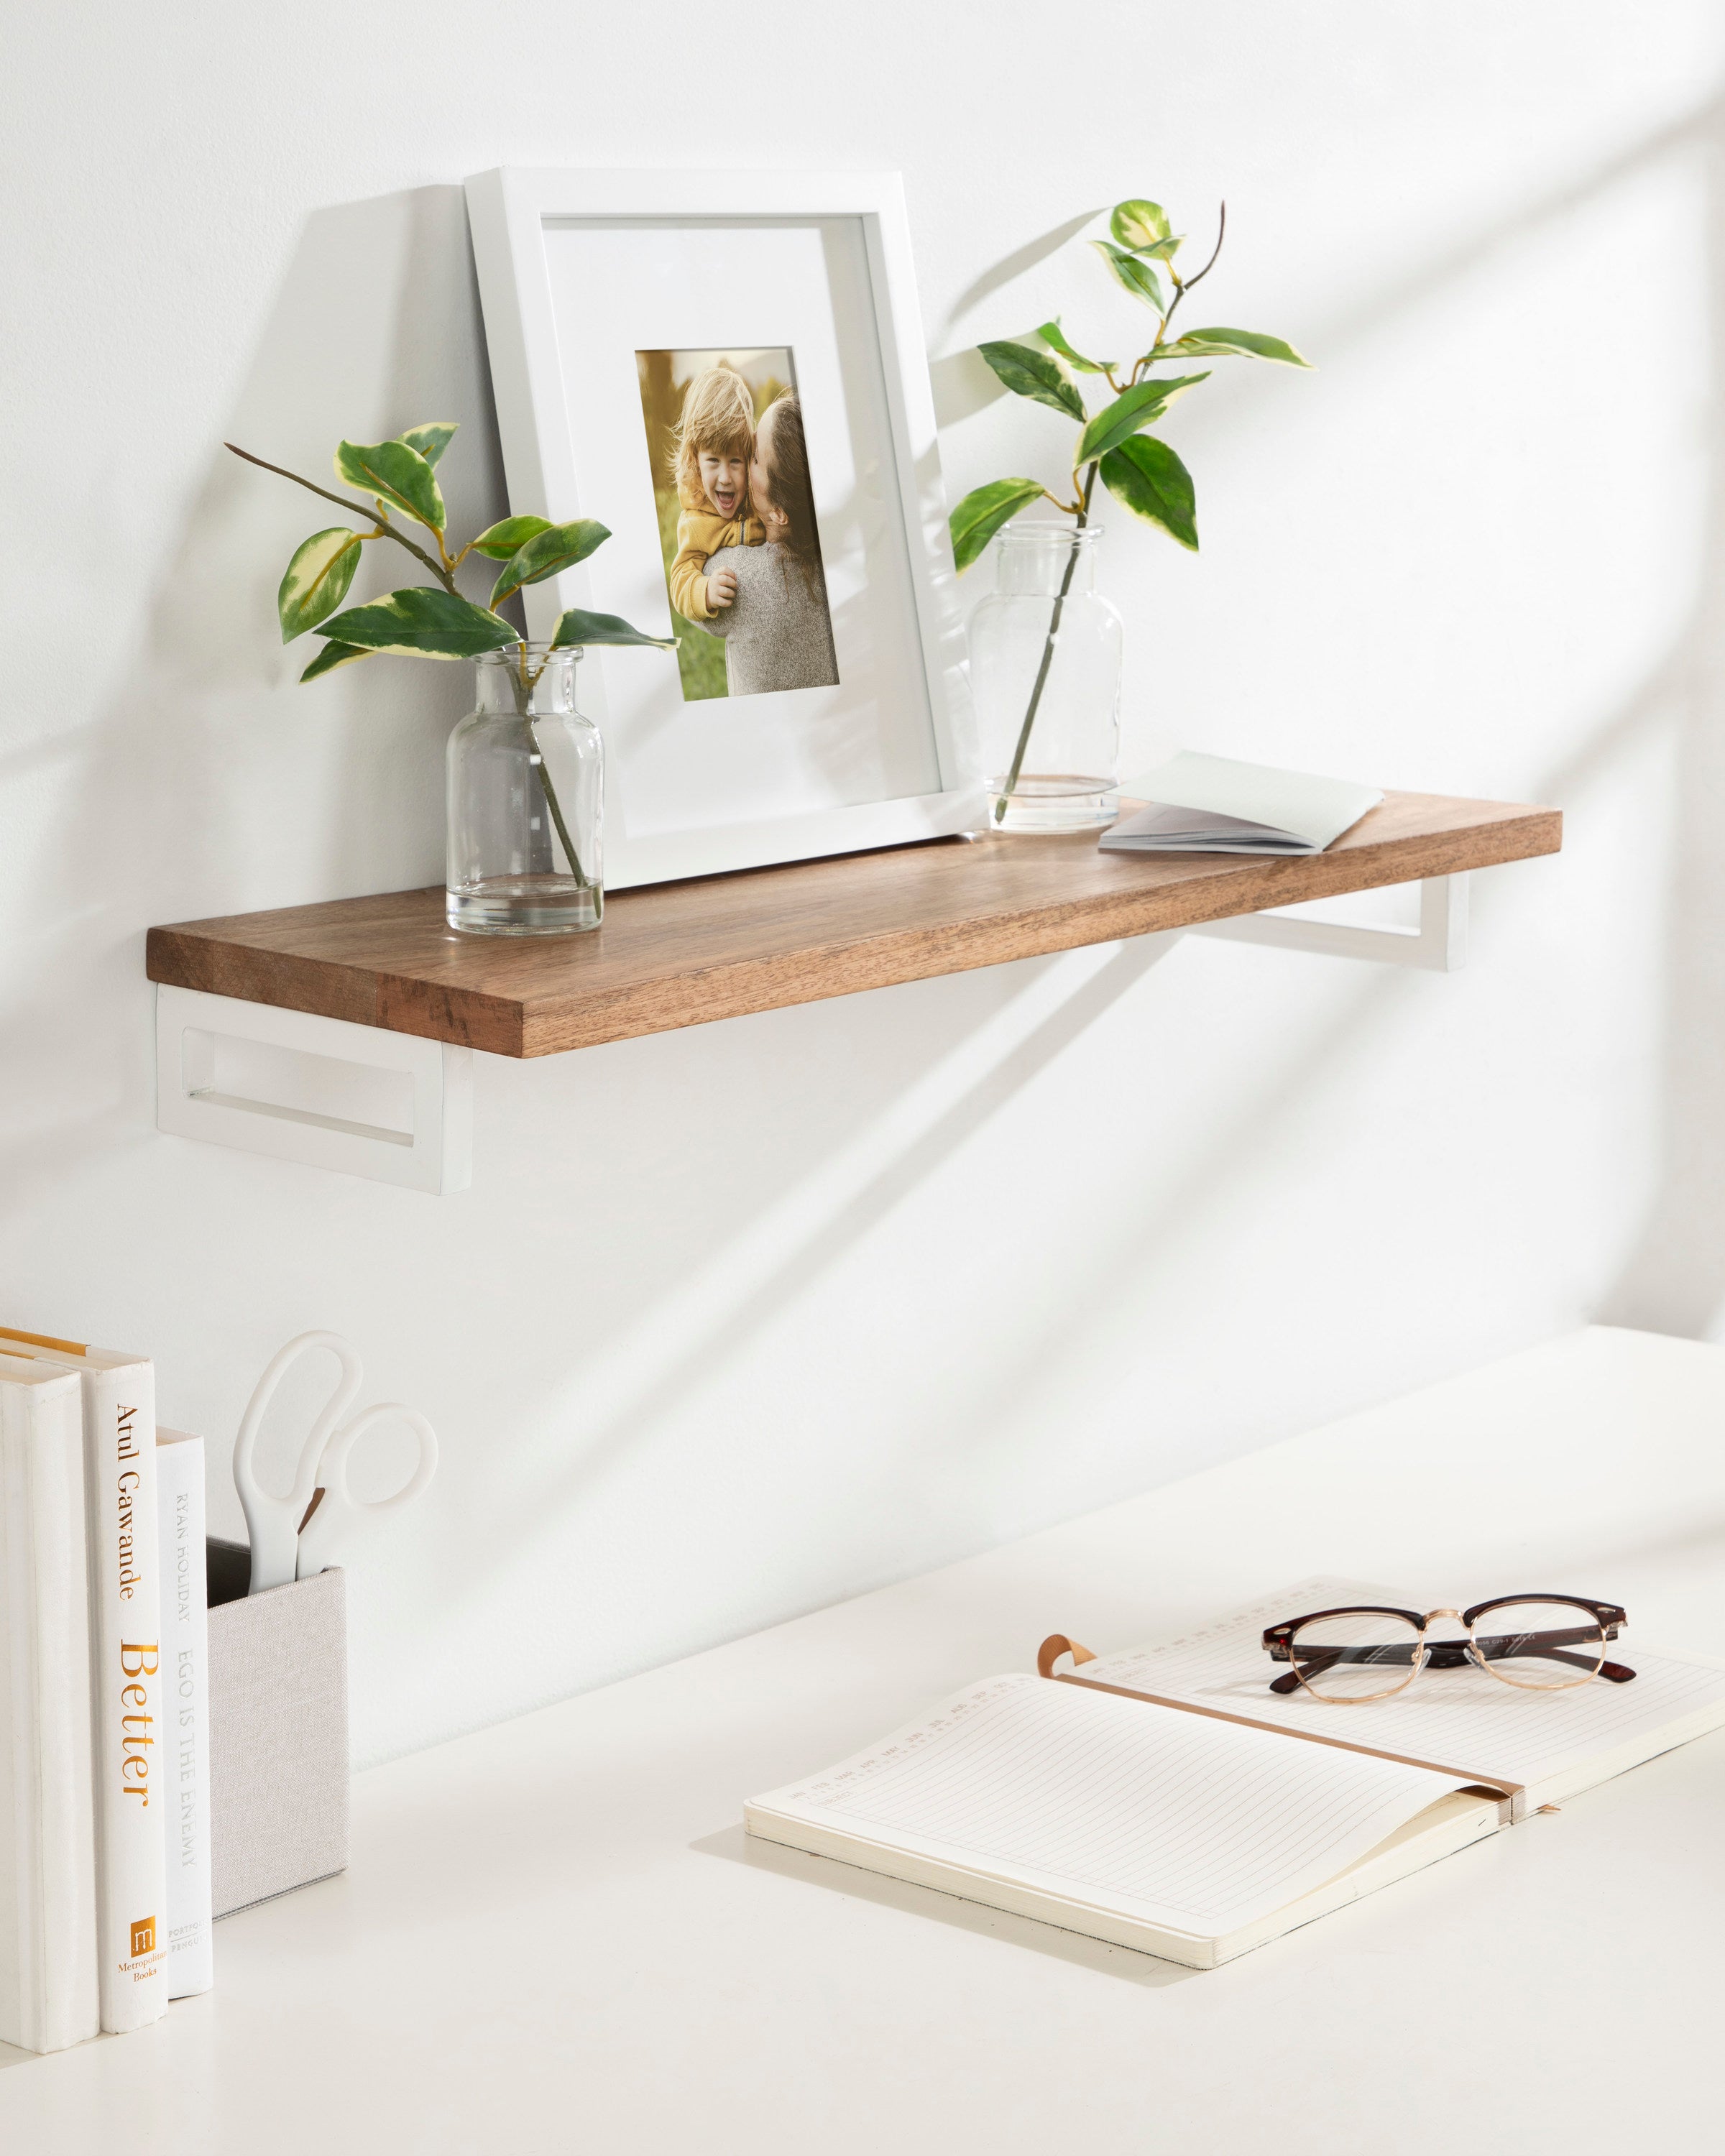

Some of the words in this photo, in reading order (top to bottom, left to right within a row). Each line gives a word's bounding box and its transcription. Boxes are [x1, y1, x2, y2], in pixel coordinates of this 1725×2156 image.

[116, 1404, 140, 1462] Atul
[117, 1471, 142, 1600] Gawande
[175, 1493, 188, 1539] RYAN
[177, 1544, 190, 1623] HOLIDAY
[178, 1648, 194, 1699] EGO
[121, 1639, 159, 1807] Better
[178, 1707, 194, 1728] IS
[180, 1733, 196, 1782] THE
[180, 1789, 197, 1869] ENEMY
[133, 1967, 157, 1983] Books
